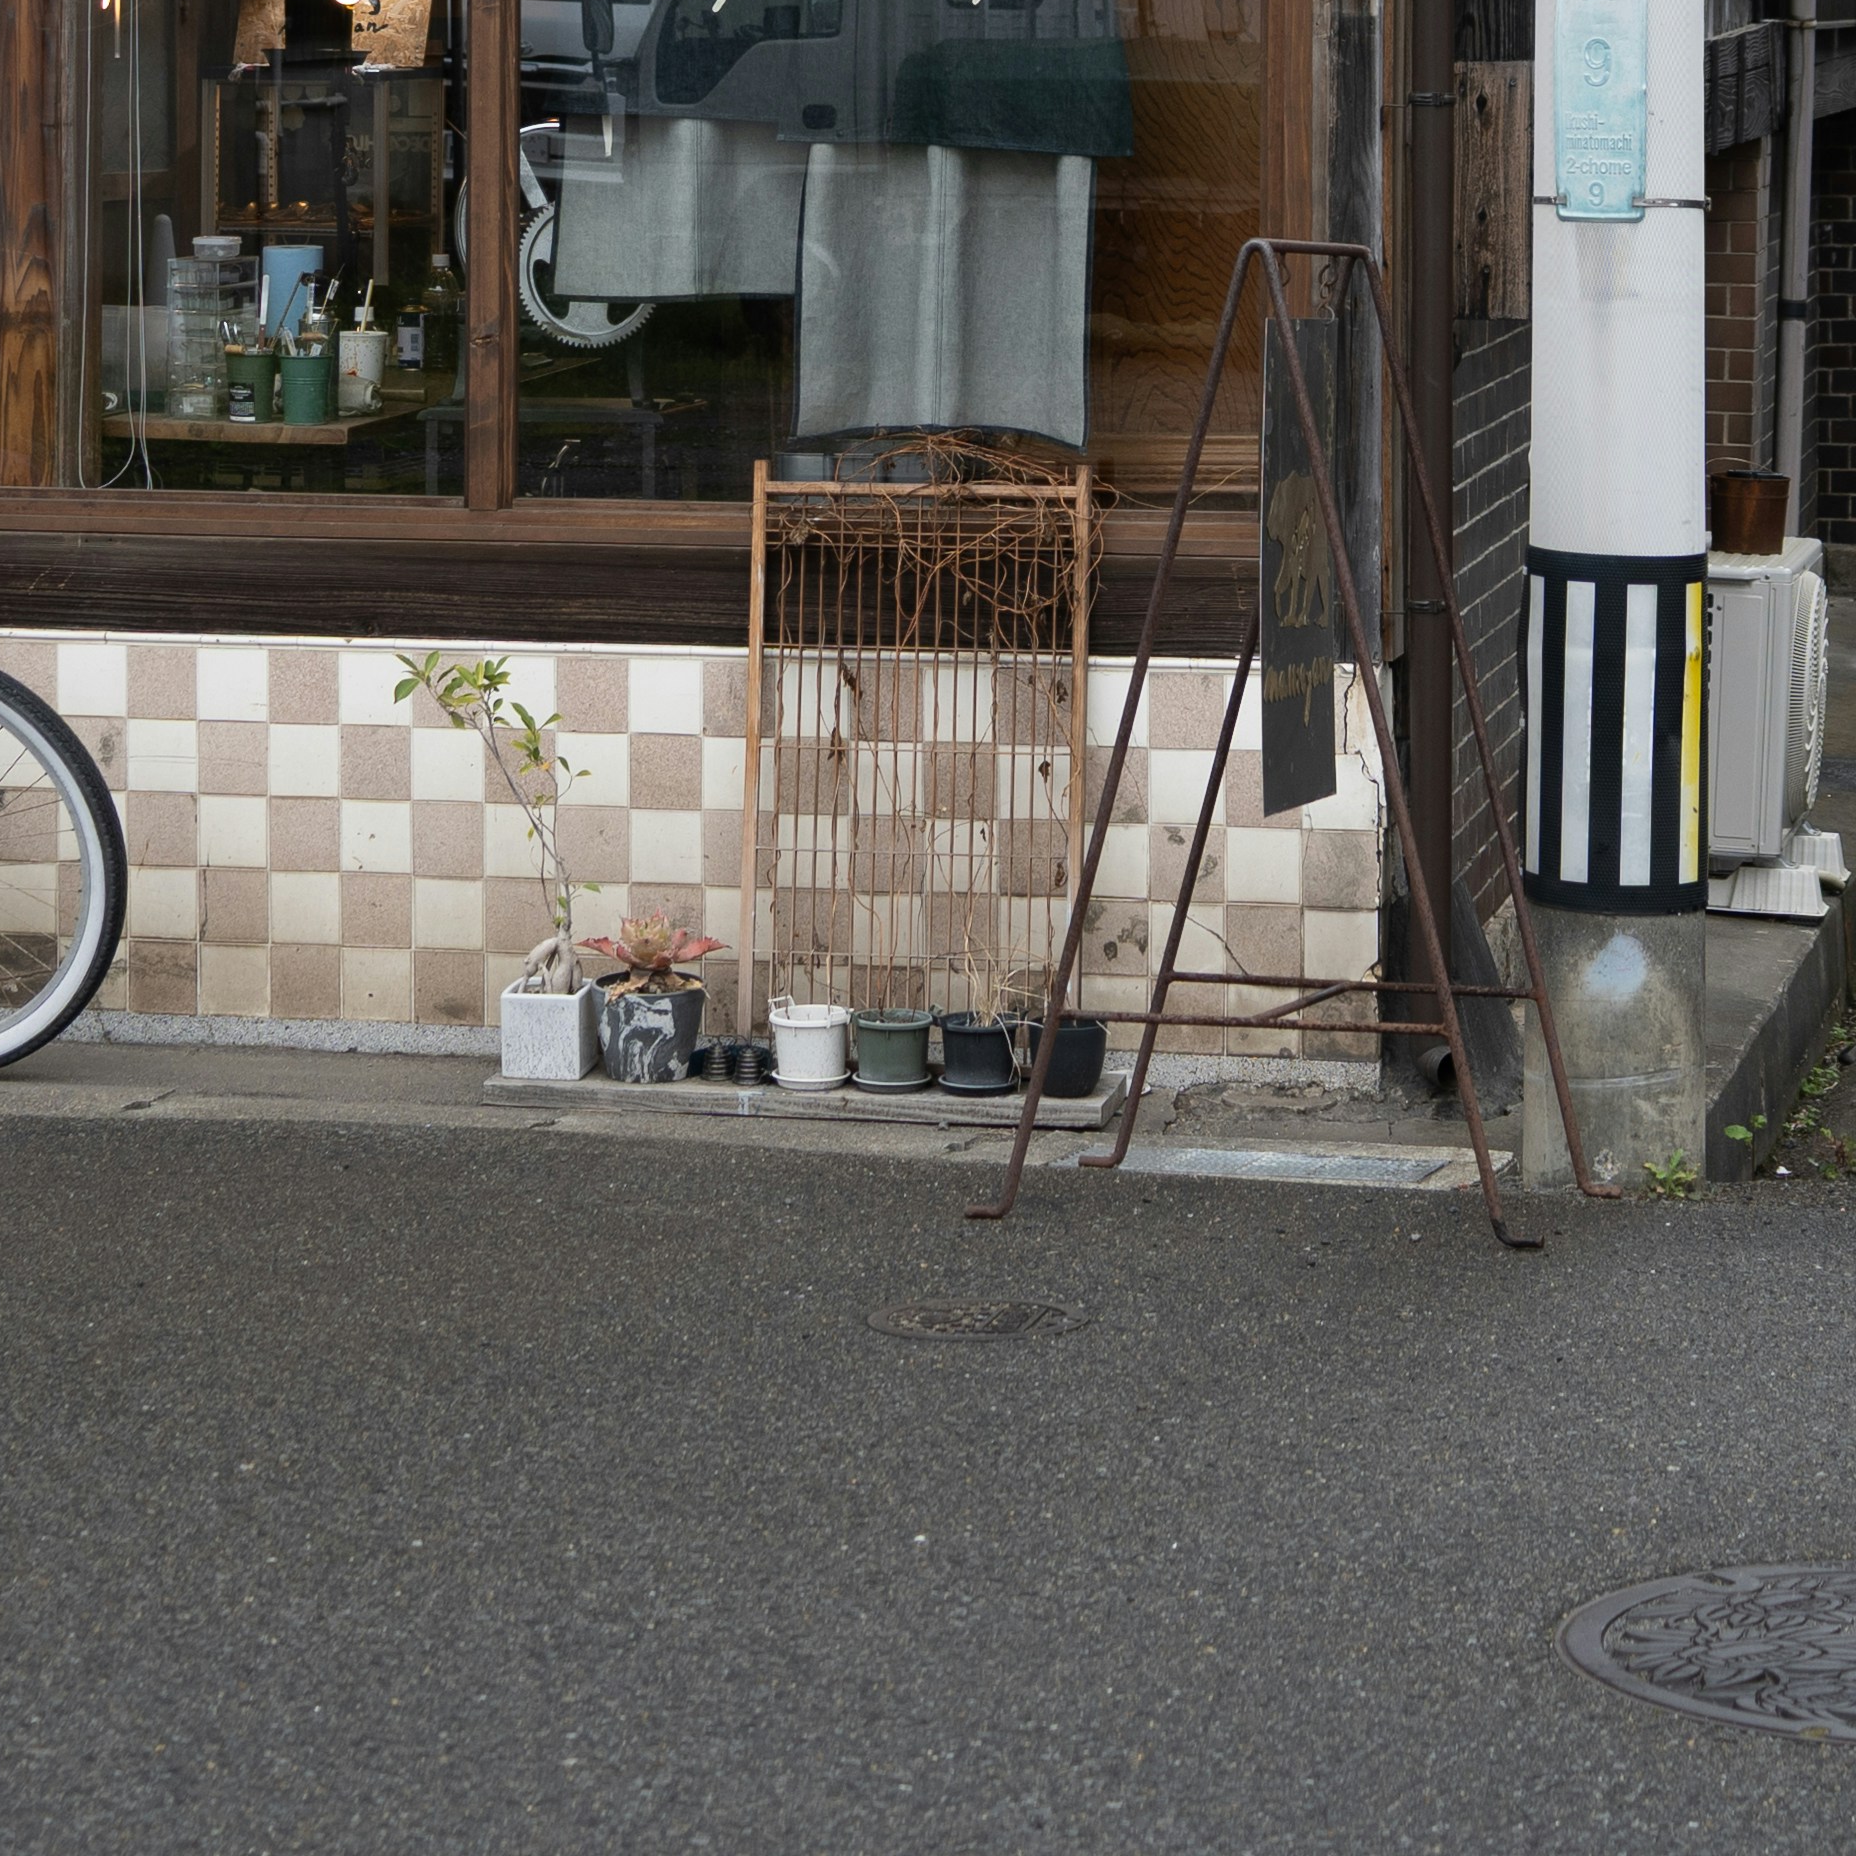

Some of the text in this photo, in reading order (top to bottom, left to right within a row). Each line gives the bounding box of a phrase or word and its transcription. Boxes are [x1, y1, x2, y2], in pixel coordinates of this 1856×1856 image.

[1583, 38, 1613, 88] 9
[1566, 157, 1632, 175] 2-chome
[1588, 181, 1605, 207] 9
